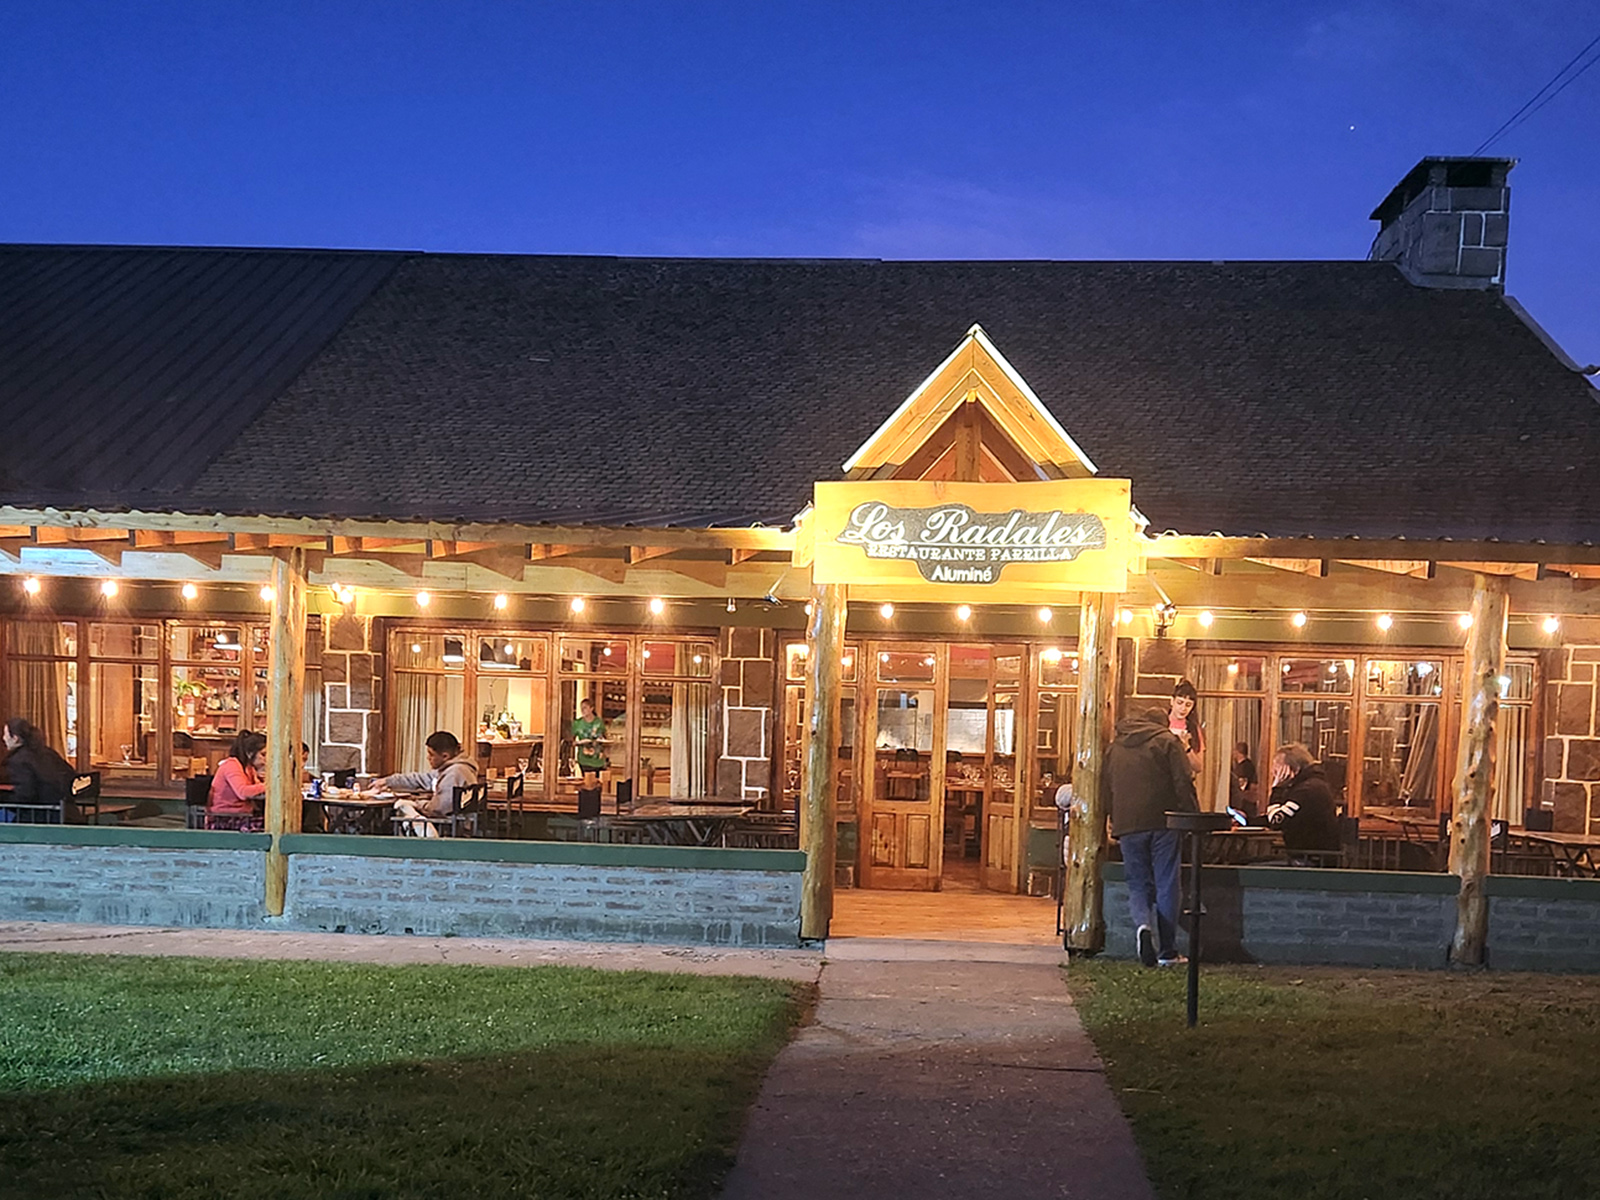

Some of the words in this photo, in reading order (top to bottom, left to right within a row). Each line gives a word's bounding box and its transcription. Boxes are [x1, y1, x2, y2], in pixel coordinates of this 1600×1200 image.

[838, 503, 907, 544] Los
[920, 507, 1098, 545] Radales
[867, 545, 985, 561] RESTAURANTE
[990, 547, 1072, 561] PARRILLA
[931, 566, 991, 582] Aluminé
